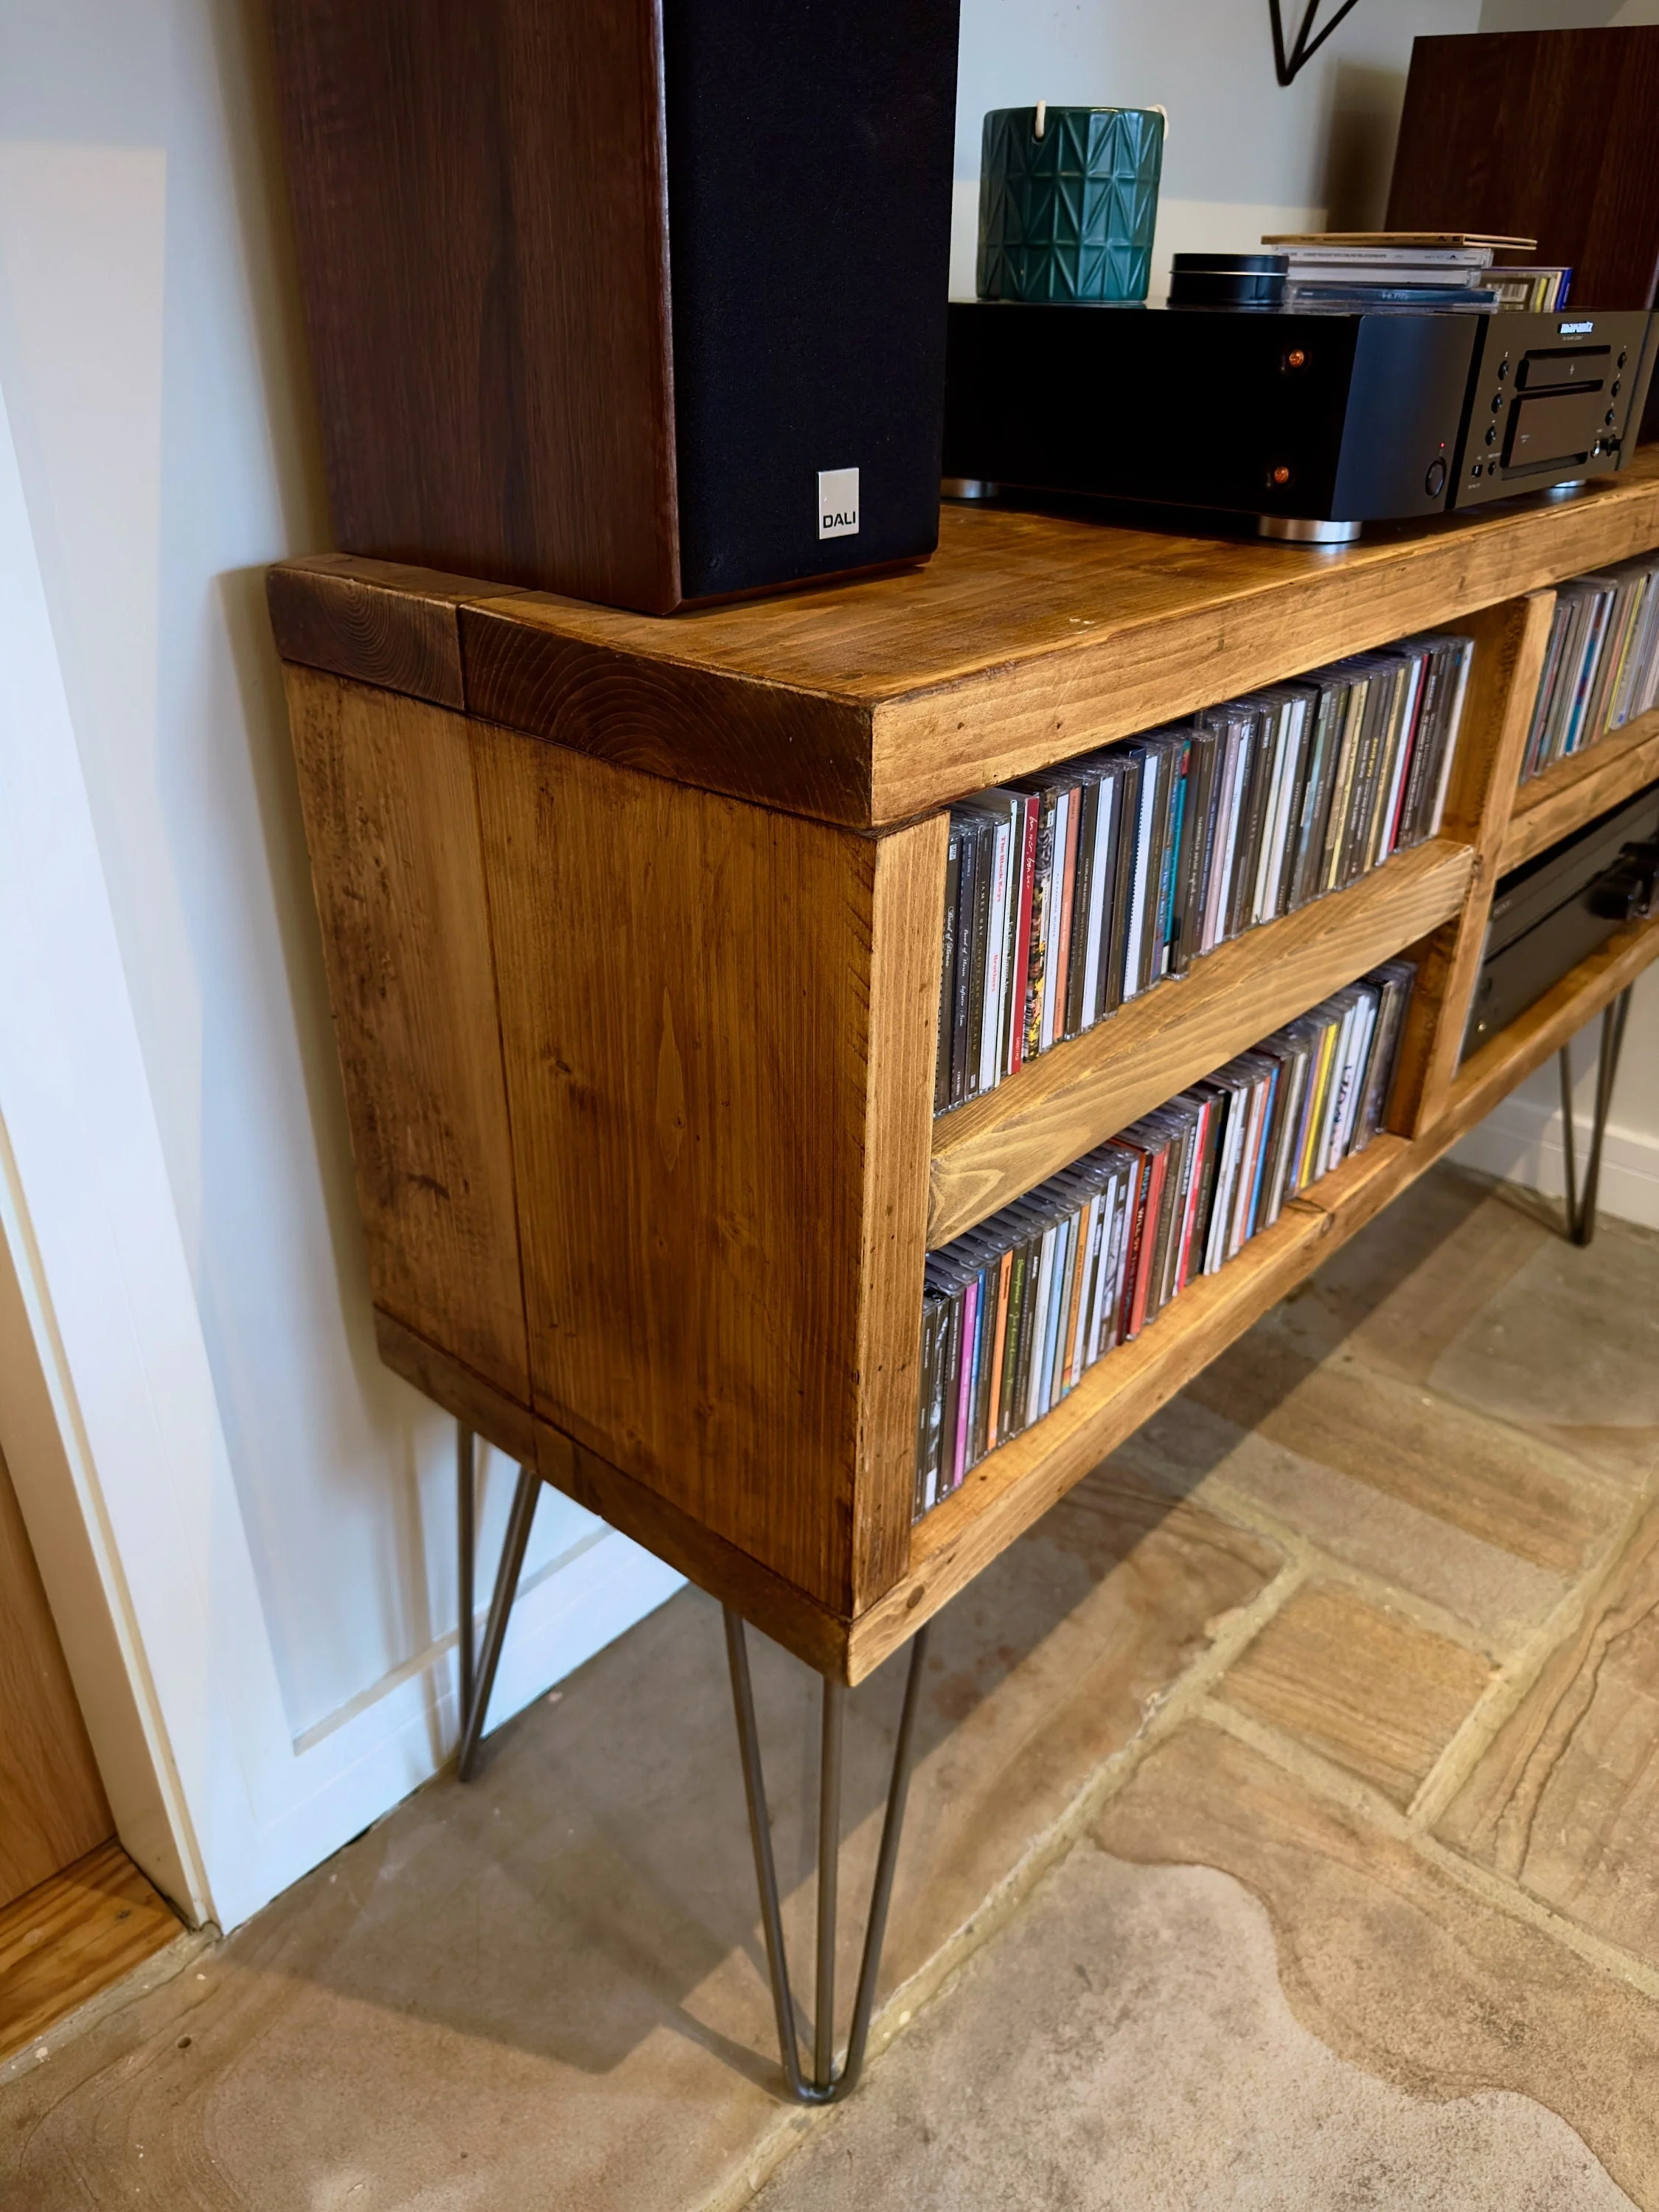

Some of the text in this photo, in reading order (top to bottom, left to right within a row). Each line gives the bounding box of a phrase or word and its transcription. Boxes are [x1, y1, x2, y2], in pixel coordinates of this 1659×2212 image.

[823, 511, 856, 529] DALI
[945, 933, 952, 941] of
[943, 942, 952, 967] Horses
[1140, 1165, 1150, 1200] MUSE
[1134, 1206, 1144, 1237] WILL
